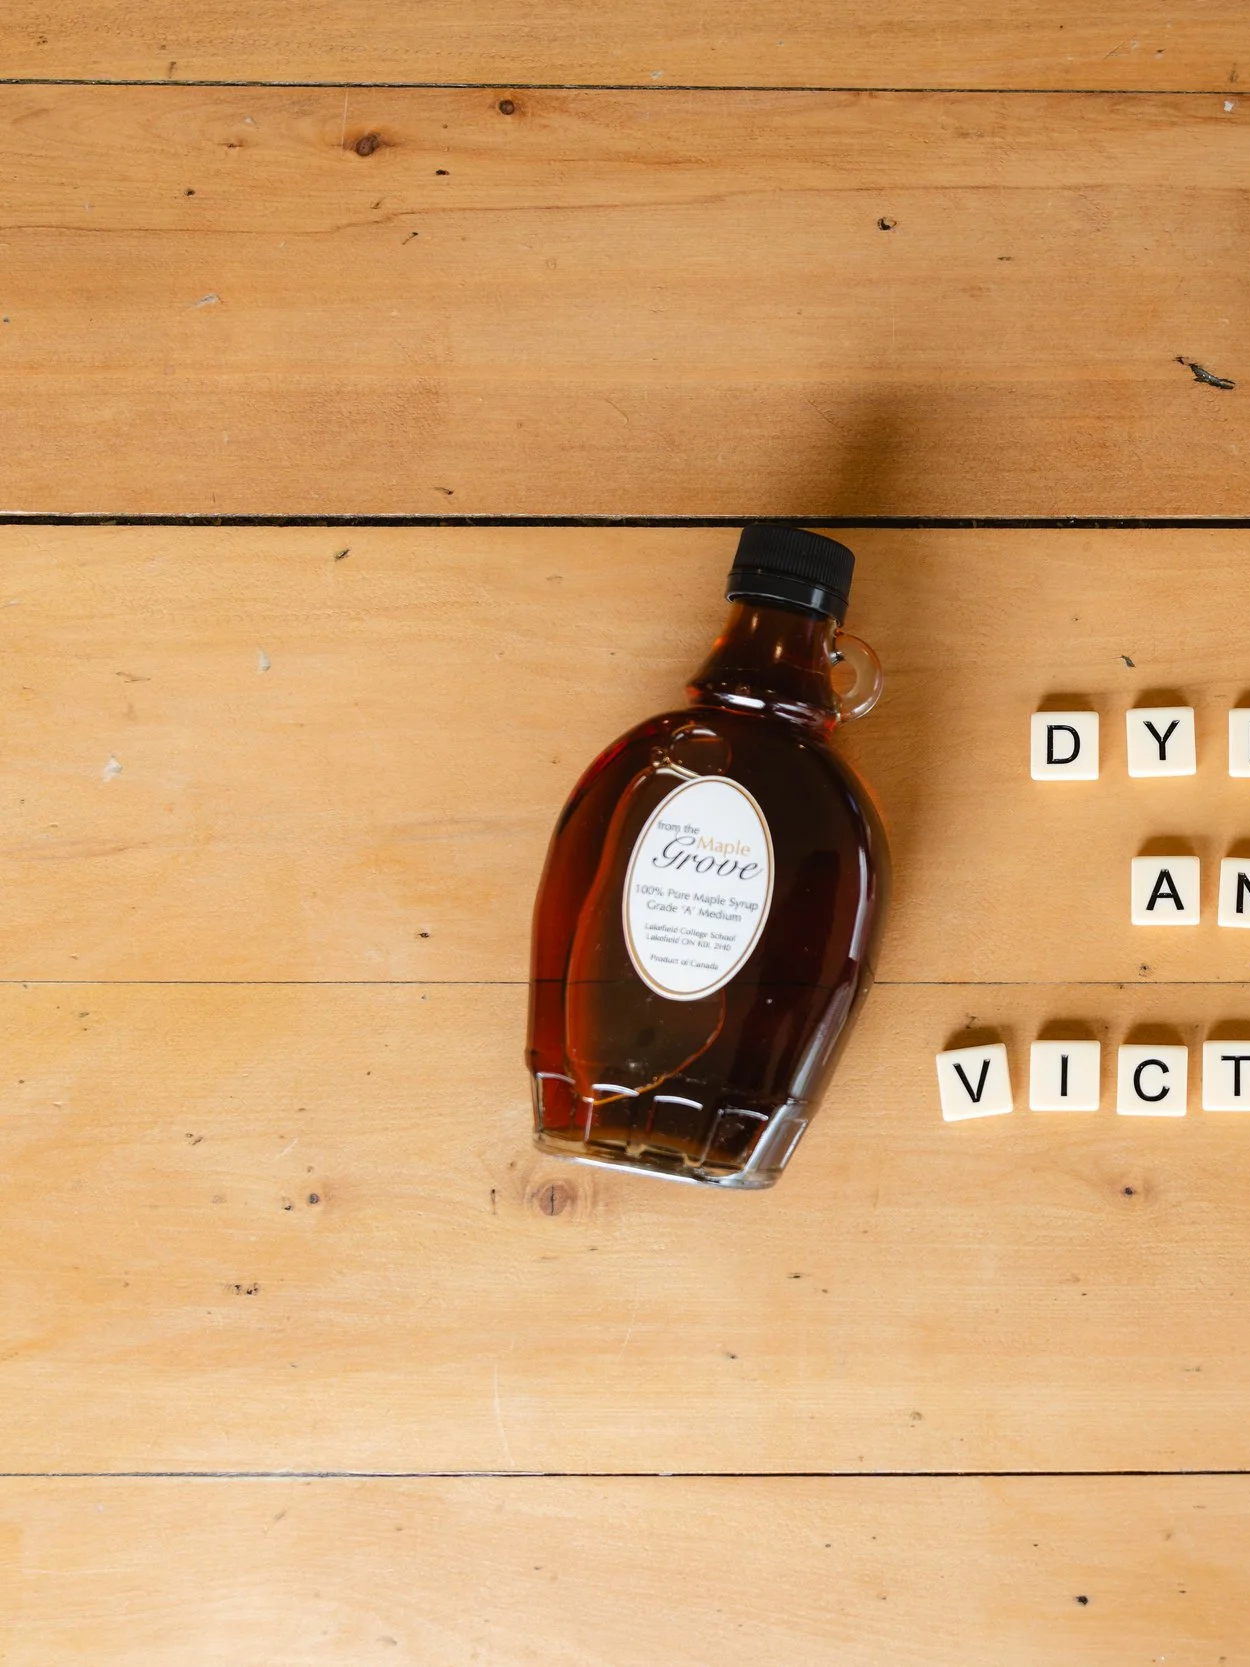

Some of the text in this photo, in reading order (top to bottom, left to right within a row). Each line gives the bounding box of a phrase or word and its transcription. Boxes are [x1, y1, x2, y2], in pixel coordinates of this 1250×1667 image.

[657, 820, 700, 834] from the
[652, 833, 764, 881] Grove
[697, 836, 751, 858] Maple
[636, 883, 759, 912] 100% Pure Maple Syrup
[646, 899, 678, 913] Grade
[698, 907, 742, 922] Medium
[644, 922, 736, 942] Lakefield College School
[646, 933, 680, 944] Lakefield
[681, 937, 695, 947] ON
[649, 953, 719, 971] Product of Canada
